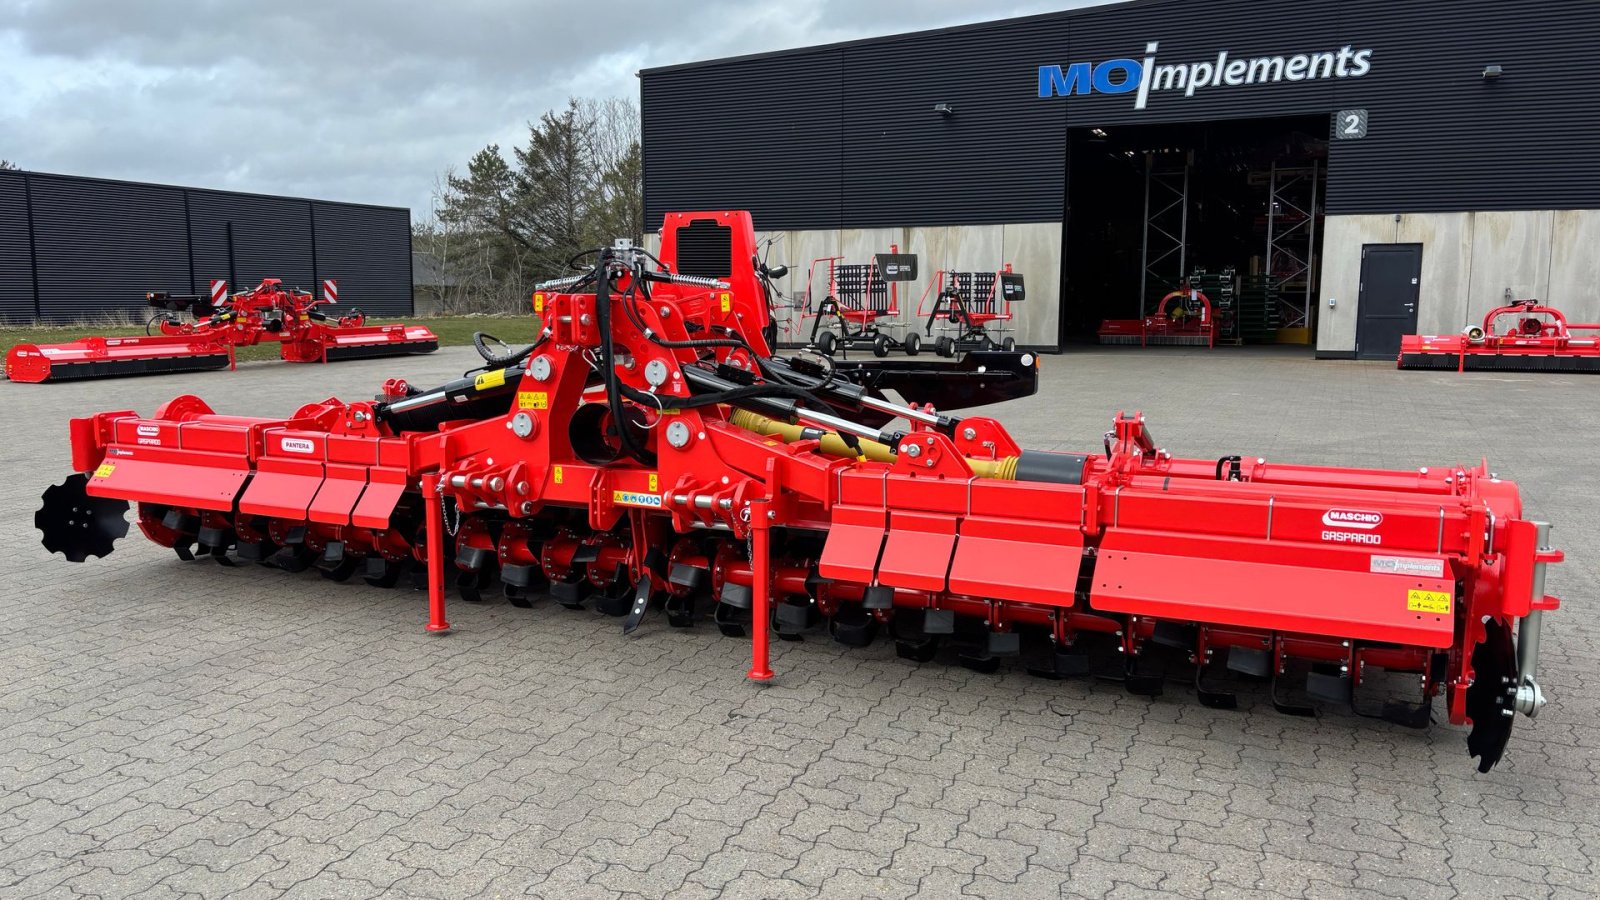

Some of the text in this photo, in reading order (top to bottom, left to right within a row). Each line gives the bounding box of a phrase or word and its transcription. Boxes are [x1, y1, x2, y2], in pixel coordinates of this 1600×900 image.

[1344, 114, 1360, 134] 2
[285, 441, 310, 450] PANTERA
[1330, 511, 1380, 523] MASCHIO
[1321, 530, 1382, 545] GASPARDO
